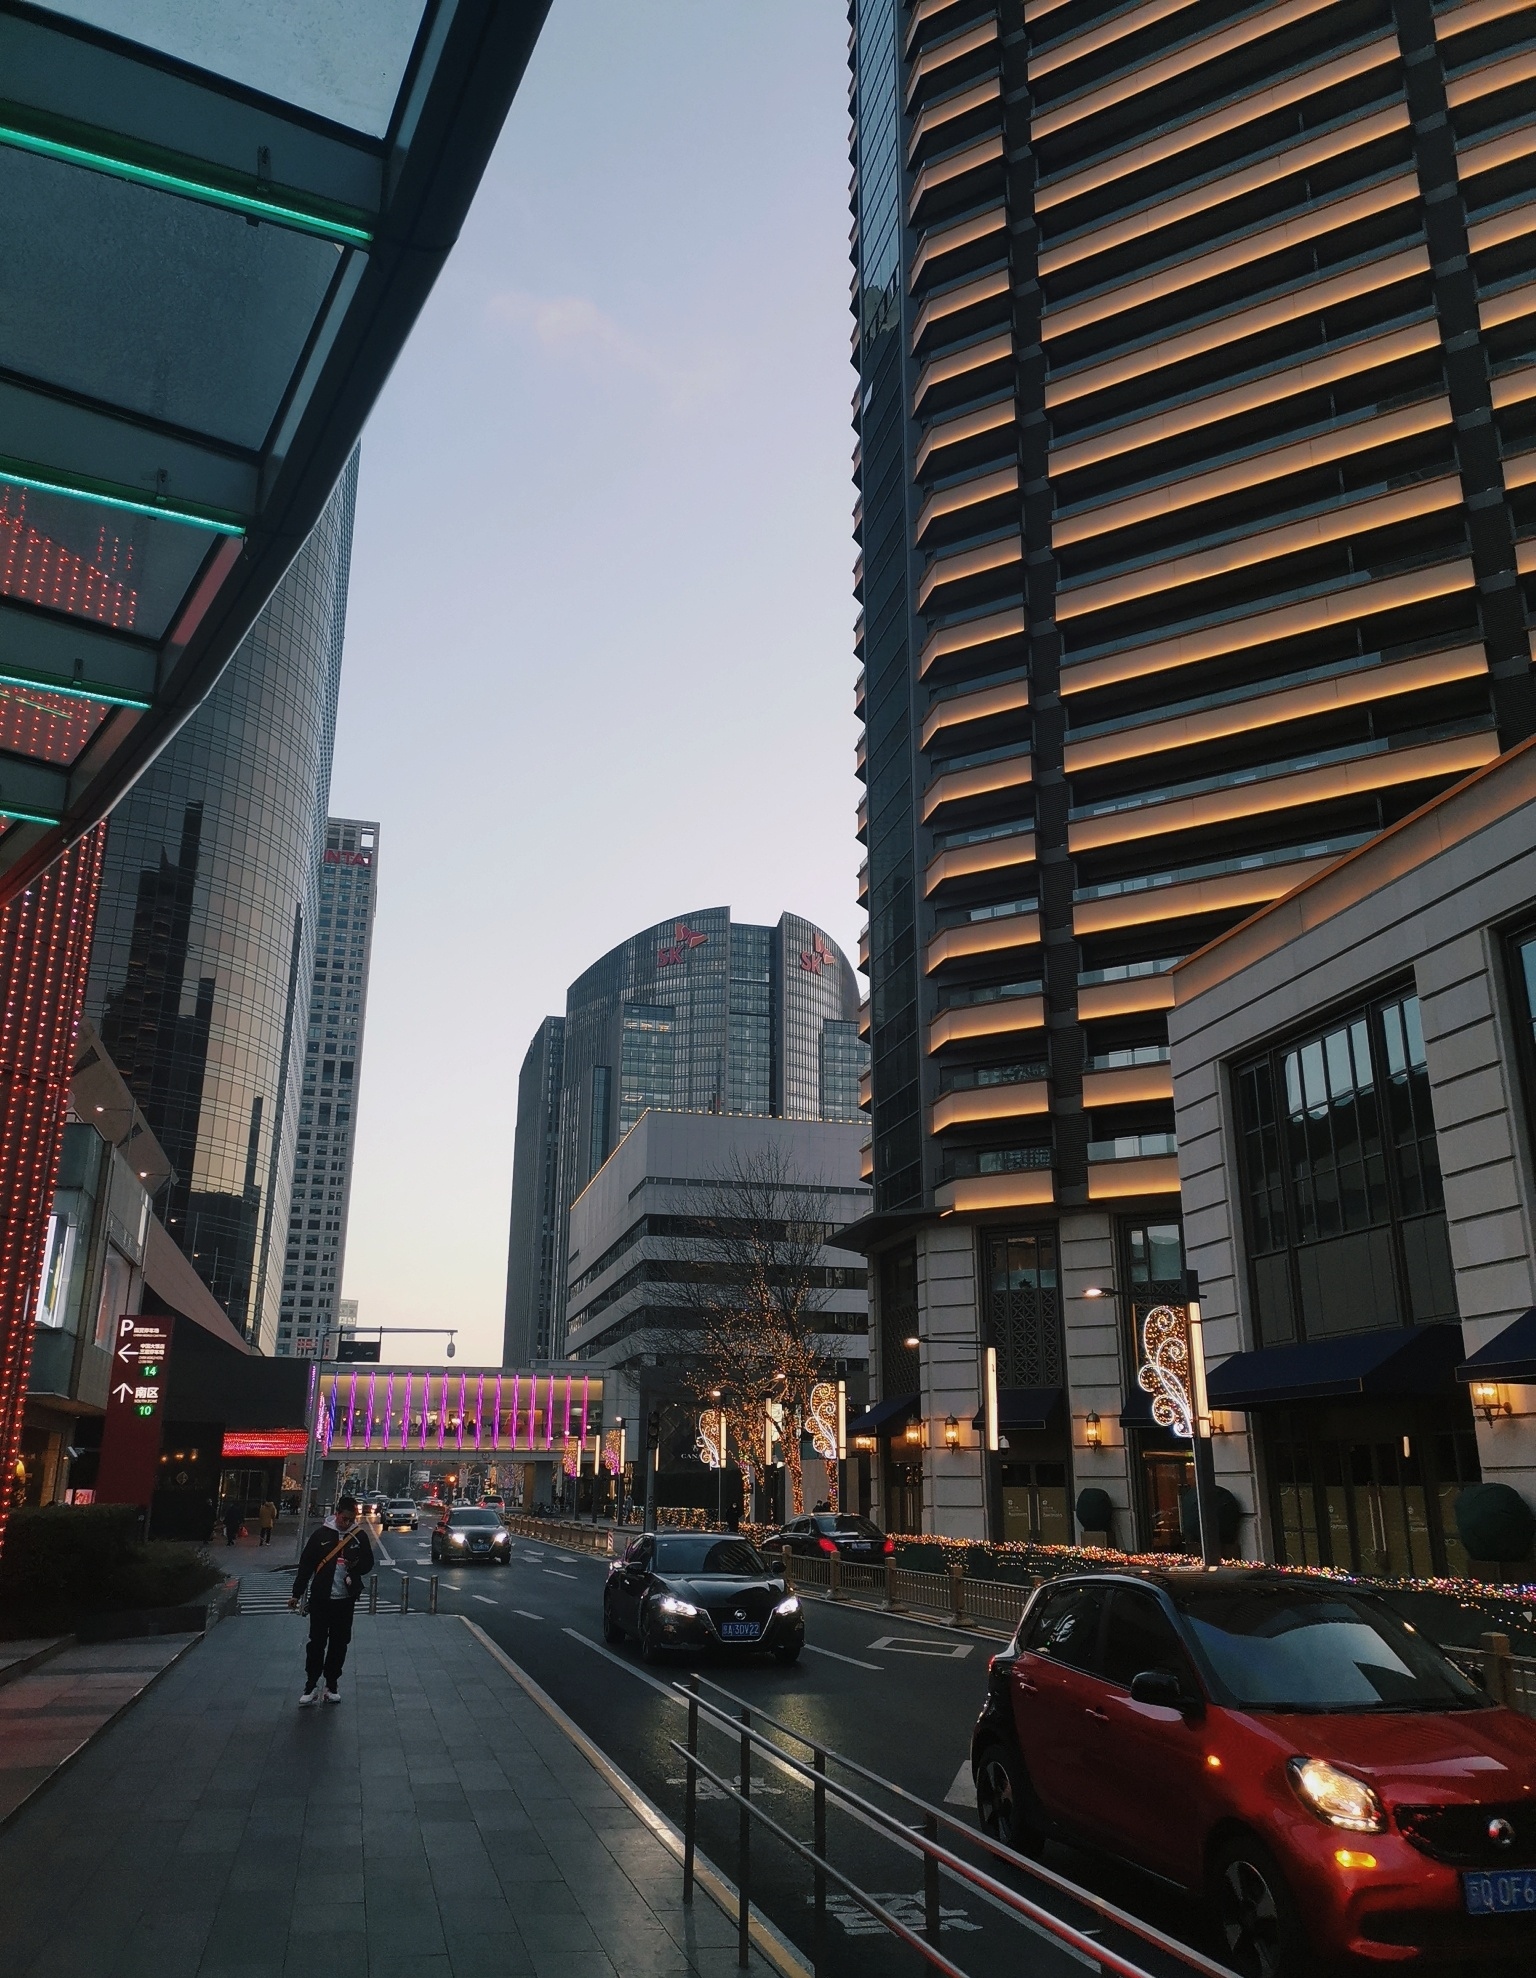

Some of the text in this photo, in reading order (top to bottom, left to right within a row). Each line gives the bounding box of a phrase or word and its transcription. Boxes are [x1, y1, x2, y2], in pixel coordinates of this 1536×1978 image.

[657, 945, 685, 968] SK
[800, 951, 822, 976] SK
[120, 1319, 134, 1337] P
[144, 1366, 157, 1376] 14
[135, 1386, 159, 1398] 南区
[139, 1405, 152, 1416] 10
